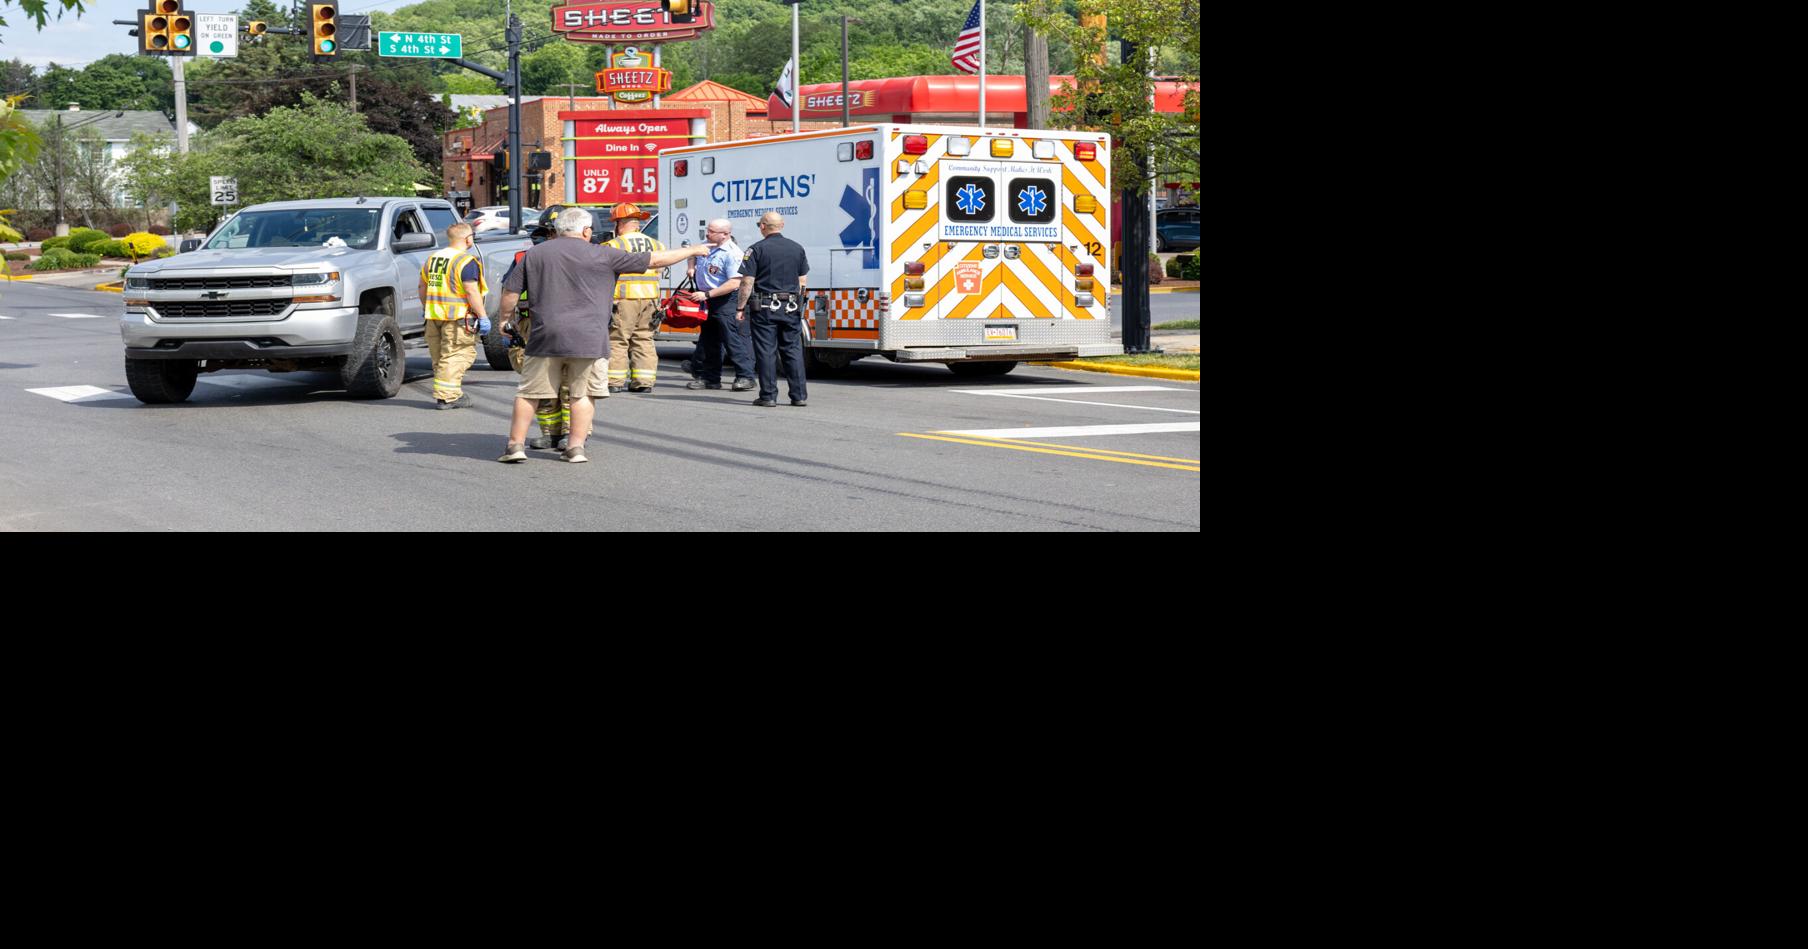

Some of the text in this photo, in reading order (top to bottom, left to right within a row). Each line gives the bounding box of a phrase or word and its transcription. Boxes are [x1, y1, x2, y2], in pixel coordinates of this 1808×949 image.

[564, 7, 696, 26] SHEET
[206, 23, 228, 31] YIELD
[405, 34, 451, 44] N 4th St
[390, 44, 435, 54] S 4th St
[609, 71, 653, 85] SHEETZ
[807, 93, 861, 108] SHEEZ
[594, 123, 668, 135] Always Open
[605, 143, 640, 152] Dine In
[583, 169, 609, 177] UNLD
[583, 177, 610, 194] 87
[711, 174, 816, 204] CITIZENS'
[214, 191, 236, 202] 25
[727, 208, 754, 219] EMERGENCY
[775, 206, 798, 216] SERVICES
[944, 225, 1058, 238] EMERGENCY MEDICAL SERVICES
[628, 237, 654, 252] IFA
[1083, 241, 1102, 257] 12
[428, 256, 450, 274] IFA
